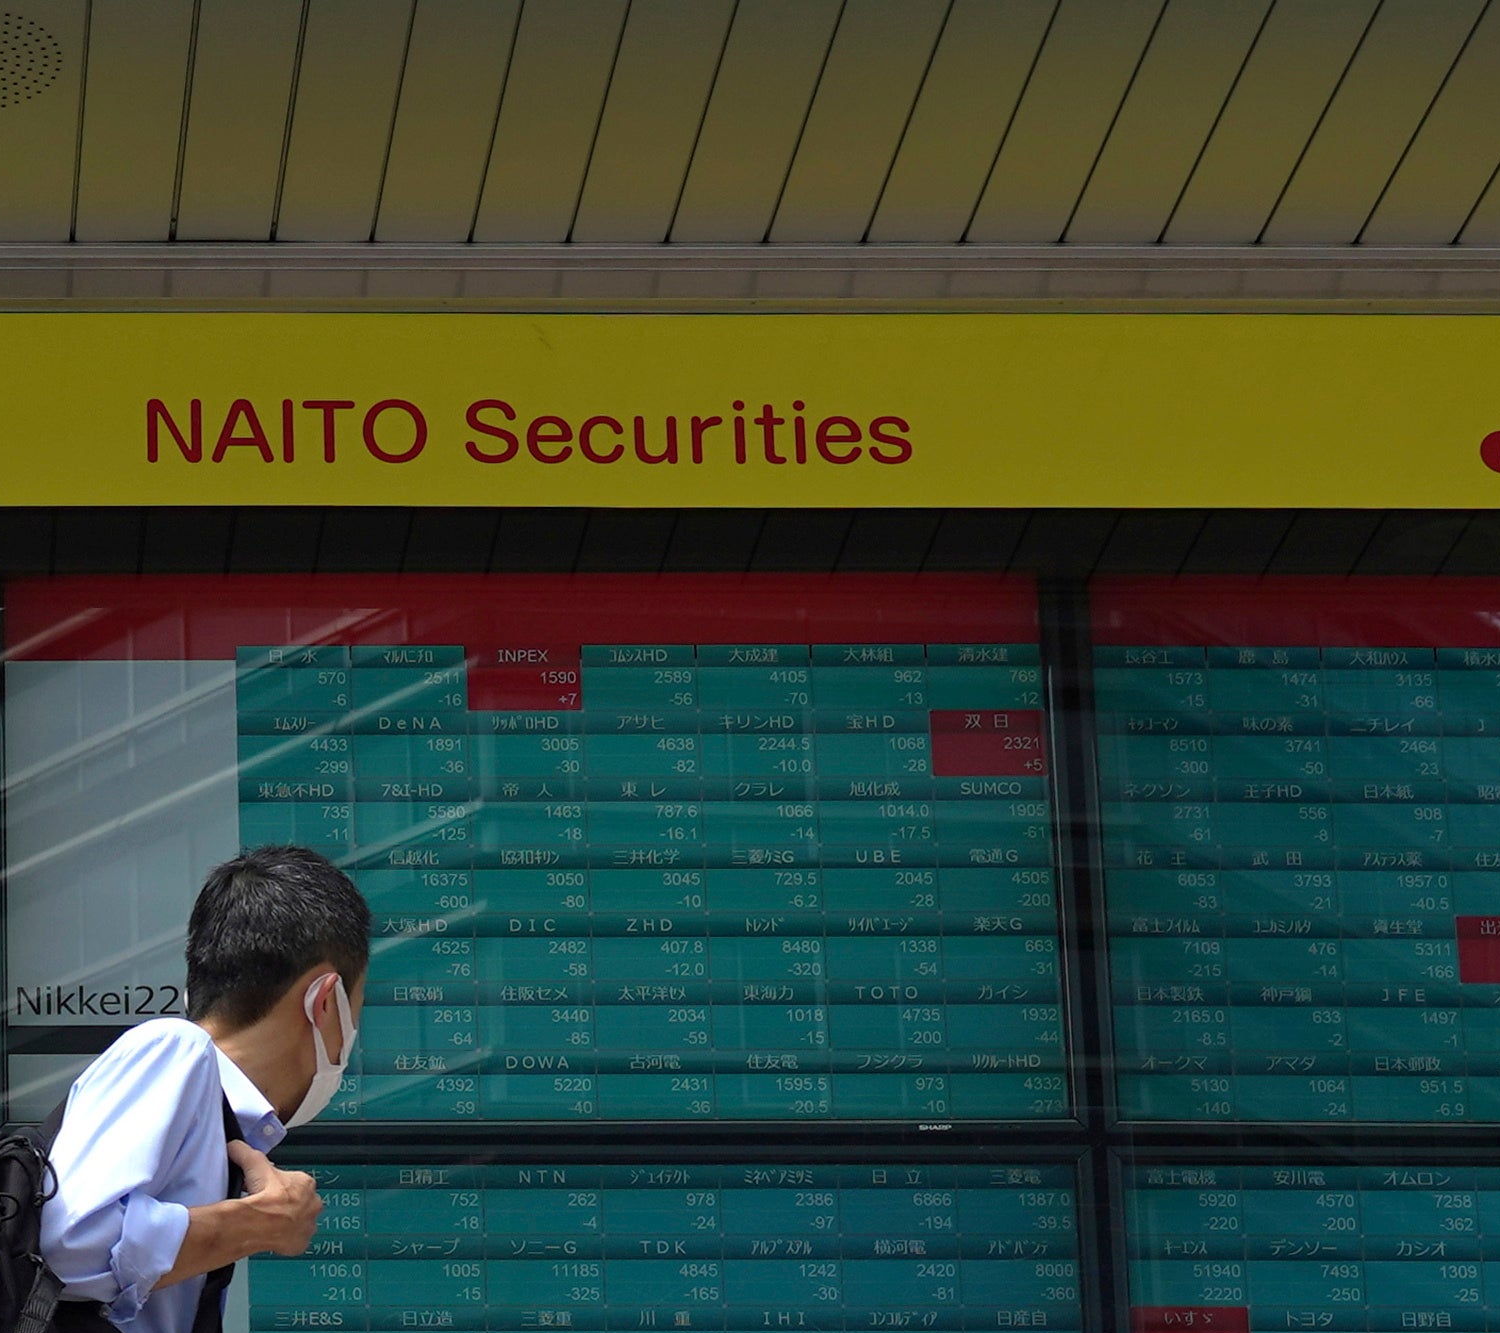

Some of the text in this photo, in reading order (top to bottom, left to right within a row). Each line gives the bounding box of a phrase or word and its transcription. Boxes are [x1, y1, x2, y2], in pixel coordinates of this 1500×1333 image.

[145, 398, 914, 465] NAITO Securities
[497, 648, 548, 663] INPEX
[727, 646, 778, 663] 大成建
[842, 646, 894, 662] 大林組
[539, 670, 577, 684] 1590
[768, 669, 808, 684] 4105
[893, 669, 923, 684] 962
[557, 692, 578, 706] +7
[783, 691, 809, 706] -70
[898, 690, 924, 705] -13
[615, 713, 665, 730] アサヒ
[717, 713, 795, 729] キリンHD
[655, 736, 695, 751] 4638
[757, 736, 812, 750] 2244.5
[1398, 739, 1437, 754] 2464
[670, 758, 696, 774] -82
[772, 758, 813, 773] -10.0
[1414, 761, 1440, 777] -23
[848, 780, 901, 797] 旭化成
[959, 779, 1022, 795] SUMCO
[1242, 782, 1303, 799] 王子HD
[877, 803, 930, 818] 1014.0
[1007, 802, 1047, 818] 1905
[1297, 805, 1329, 820] 556
[890, 825, 931, 840] -17.5
[1022, 825, 1047, 840] -61
[1313, 828, 1329, 843] -8
[612, 848, 681, 865] 三井化学
[968, 847, 1019, 864] 電通G
[662, 871, 703, 886] 3045
[1010, 870, 1050, 885] 4505
[676, 893, 702, 908] -10
[1016, 892, 1052, 907] -200
[972, 915, 1023, 932] 楽天G
[1024, 937, 1054, 954] 663
[1030, 961, 1056, 976] -31
[393, 985, 444, 1002] 日電硝
[1135, 984, 1205, 1002] 日本製鉄
[433, 1008, 472, 1023] 2613
[1171, 1008, 1225, 1024] 2165.0
[447, 1031, 473, 1045] -64
[1195, 1031, 1227, 1046] -8.5
[628, 1052, 682, 1070] 古河電
[670, 1076, 708, 1092] 2431
[685, 1099, 713, 1114] -36
[988, 1167, 1042, 1185] 三菱電
[1382, 1169, 1452, 1186] オムロン
[1018, 1191, 1071, 1207] 1387.0
[1433, 1193, 1473, 1209] 7258
[1032, 1214, 1075, 1230] -39.5
[1438, 1216, 1475, 1232] -362
[390, 1236, 461, 1255] シャープ
[1268, 1237, 1338, 1256] デンソー
[1395, 1239, 1448, 1257] カシオ
[441, 1262, 481, 1278] 1005
[1319, 1262, 1360, 1279] 7493
[1438, 1263, 1478, 1279] 1309
[455, 1286, 482, 1301] -15
[1325, 1286, 1361, 1302] -250
[1452, 1287, 1480, 1303] -25
[273, 1309, 343, 1327] 三井E&S
[996, 1308, 1047, 1326] 日産自
[1285, 1309, 1334, 1327] トヨタ
